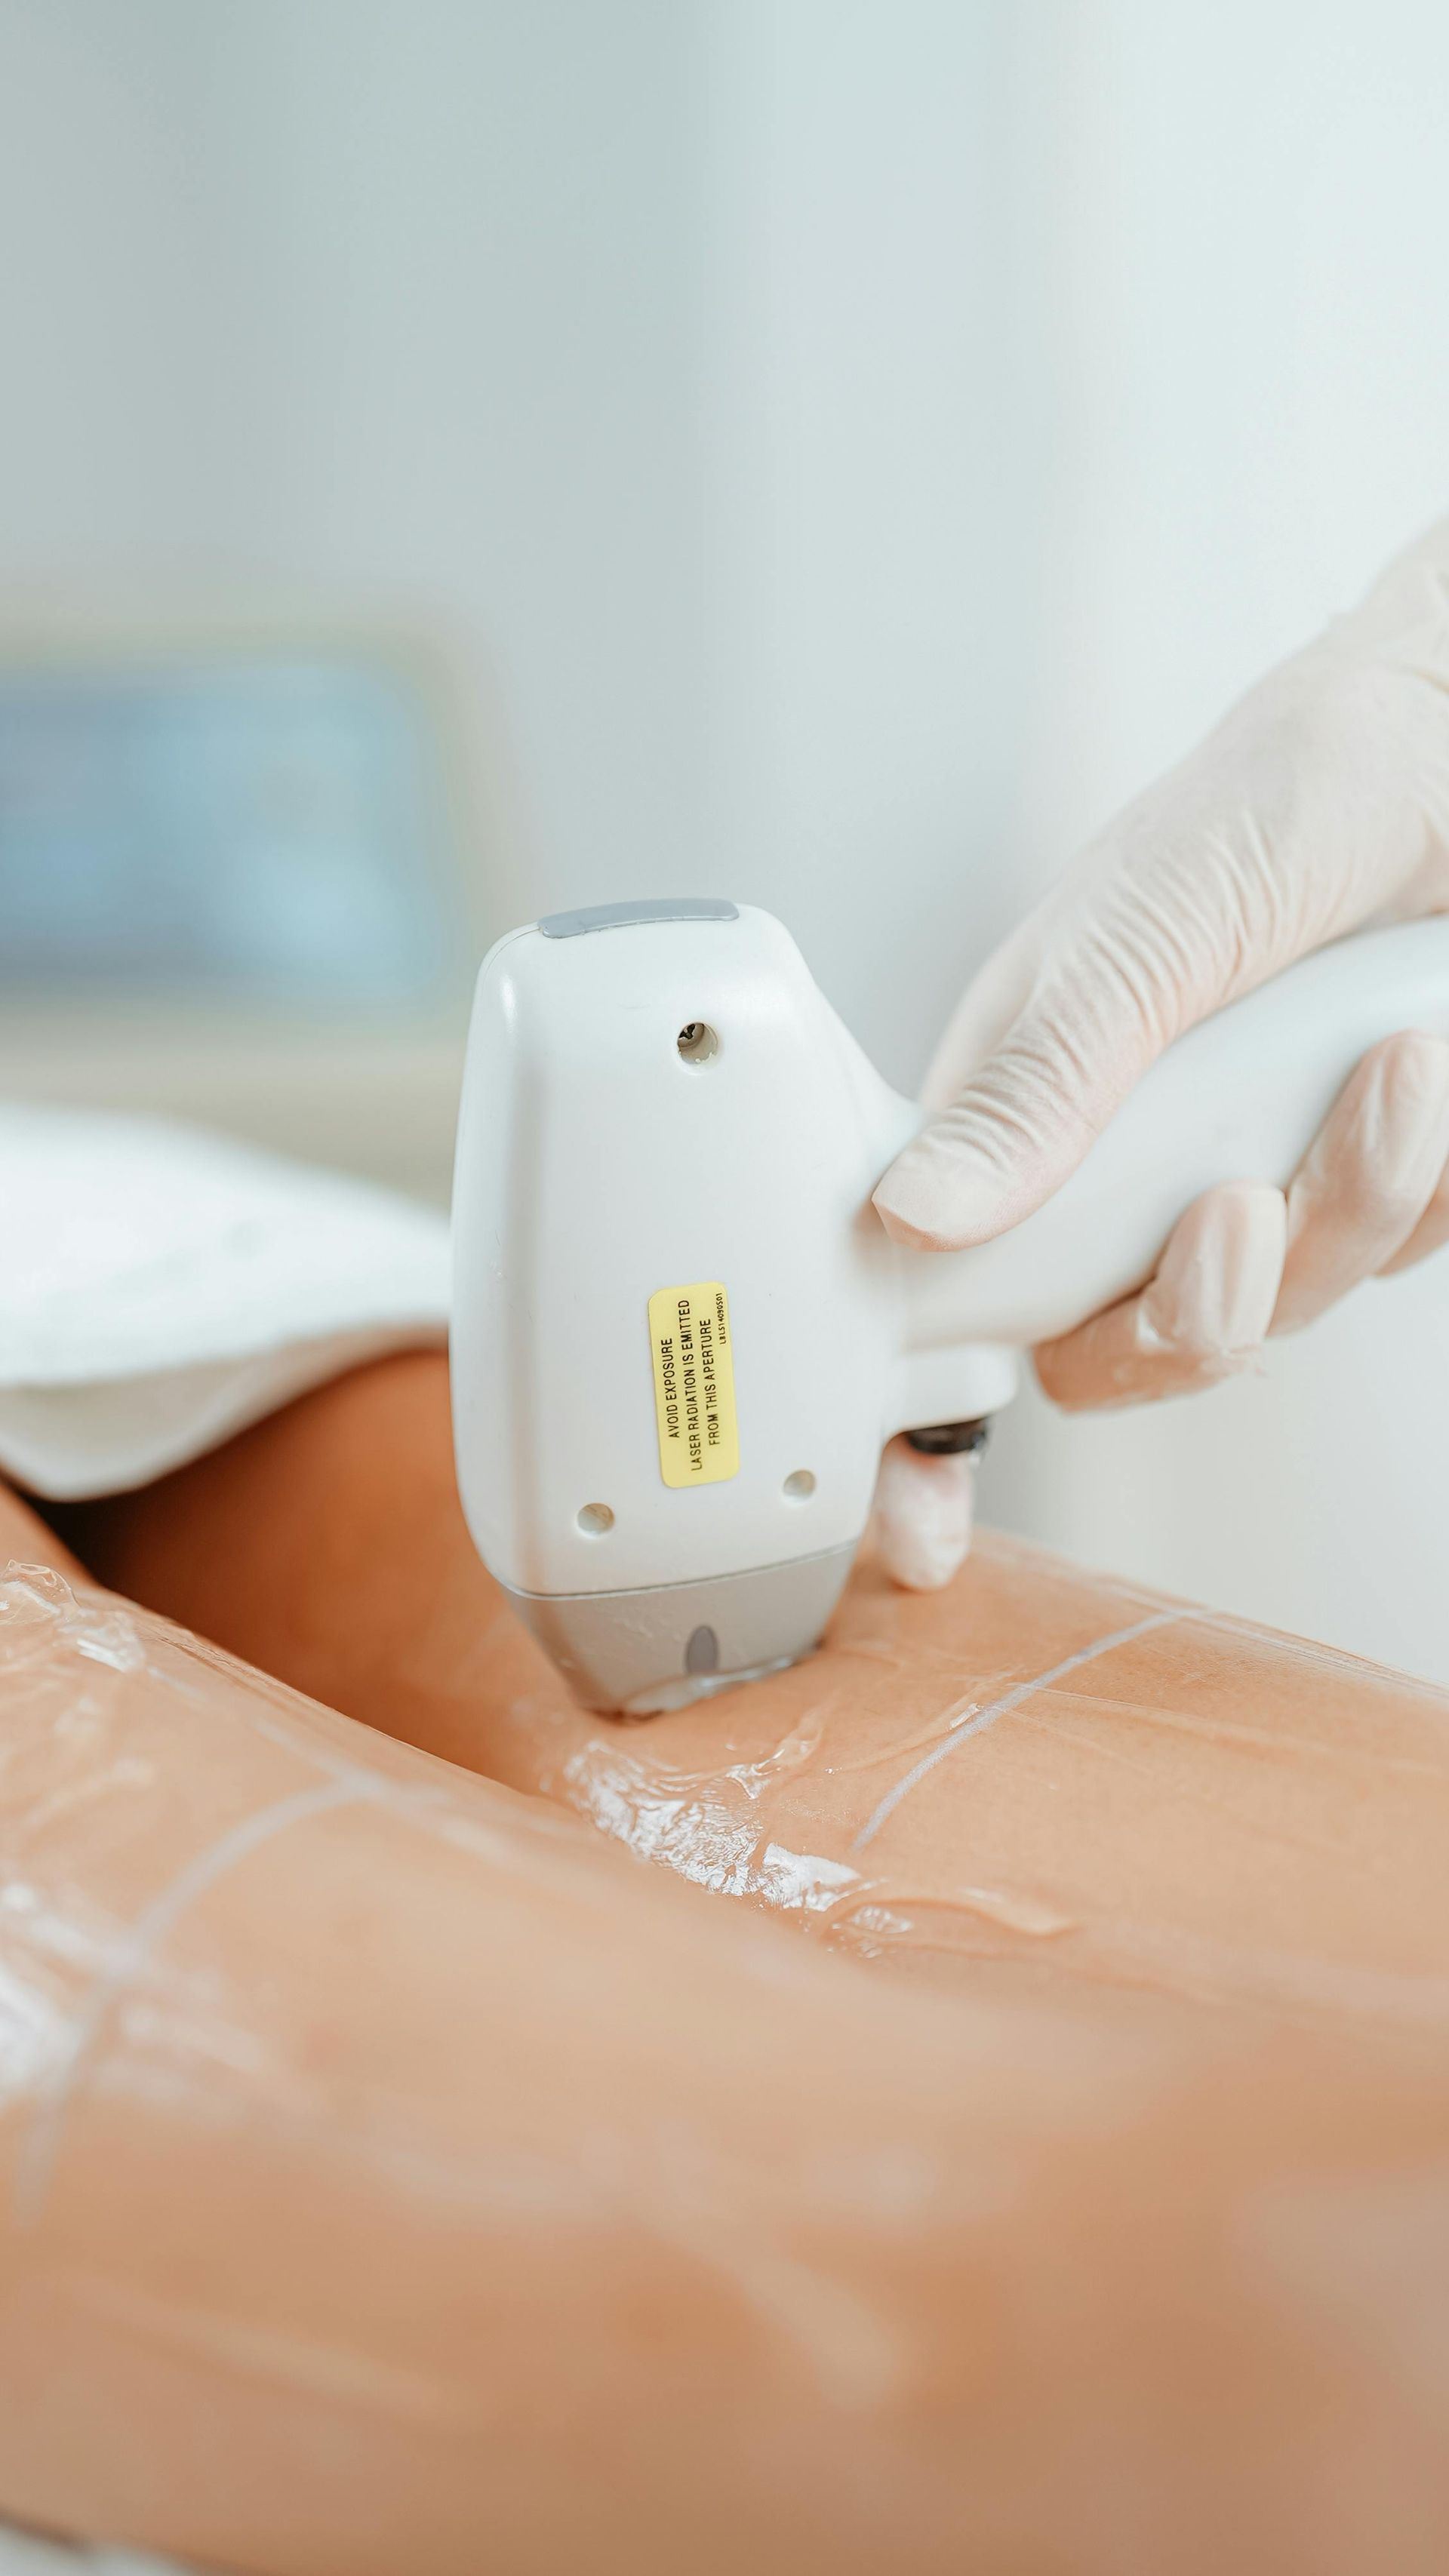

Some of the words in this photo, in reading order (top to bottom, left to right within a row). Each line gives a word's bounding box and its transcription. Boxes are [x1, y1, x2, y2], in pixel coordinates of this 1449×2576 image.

[678, 1300, 693, 1351] EMITTED
[682, 1354, 694, 1366] IS
[700, 1319, 715, 1381] APERTURE
[661, 1338, 677, 1401] EXPOSURE
[684, 1369, 698, 1434] RADIATION
[704, 1384, 718, 1410] THIS
[666, 1405, 679, 1438] AVOID
[707, 1415, 720, 1446] FROM
[689, 1434, 702, 1471] LASER
